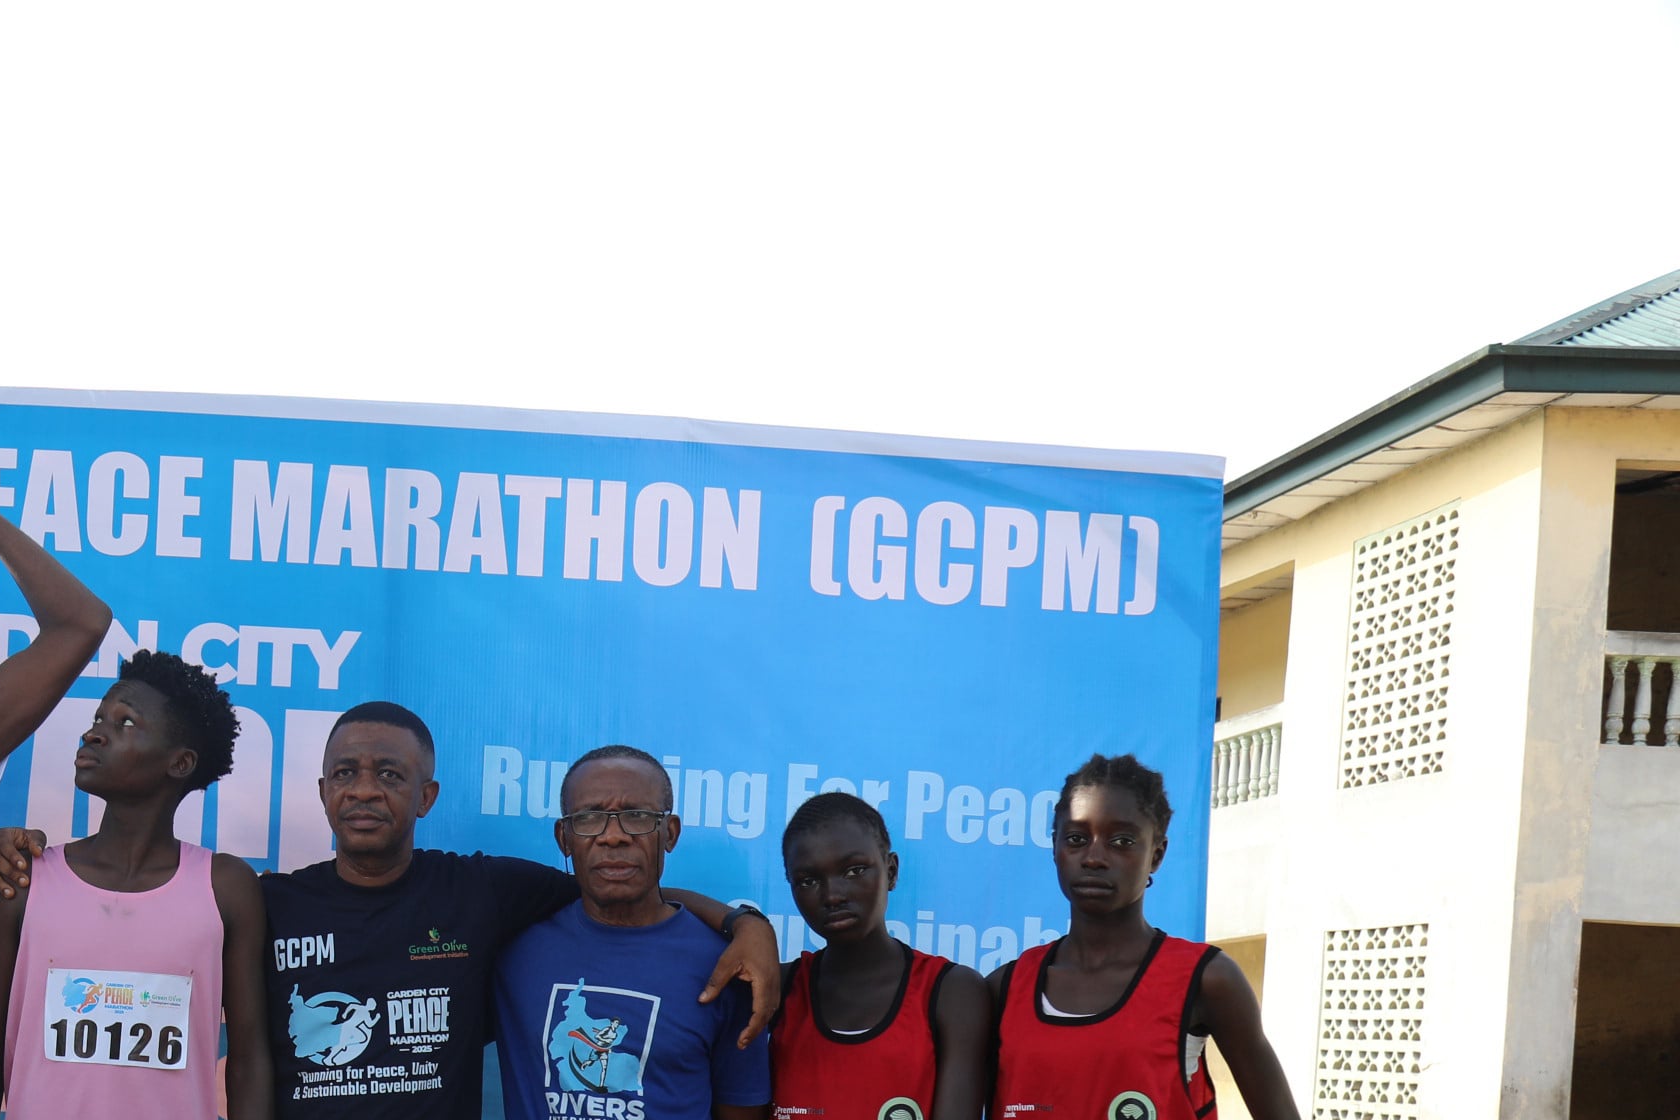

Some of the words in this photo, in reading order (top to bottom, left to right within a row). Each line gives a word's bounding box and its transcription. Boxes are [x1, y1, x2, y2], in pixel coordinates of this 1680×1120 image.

[229, 459, 762, 591] MARATHON
[810, 494, 1160, 616] (GCPM)
[181, 621, 363, 690] CITY
[480, 744, 768, 840] Ruing
[904, 770, 1060, 847] Peac
[274, 933, 335, 972] GCPM
[408, 945, 440, 954] Green
[441, 939, 468, 951] Olive
[104, 987, 134, 1005] PEACE
[386, 988, 427, 1000] GARDEN
[428, 987, 450, 996] CITY
[387, 996, 451, 1035] PEACE
[50, 1019, 183, 1065] 10126
[390, 1033, 450, 1045] MARATHON
[411, 1045, 433, 1054] 2025
[346, 1066, 365, 1080] for
[367, 1064, 409, 1079] Peace,
[411, 1061, 439, 1077] Unity
[293, 1087, 301, 1100] &
[302, 1081, 368, 1099] Sustainable
[370, 1076, 443, 1095] Development
